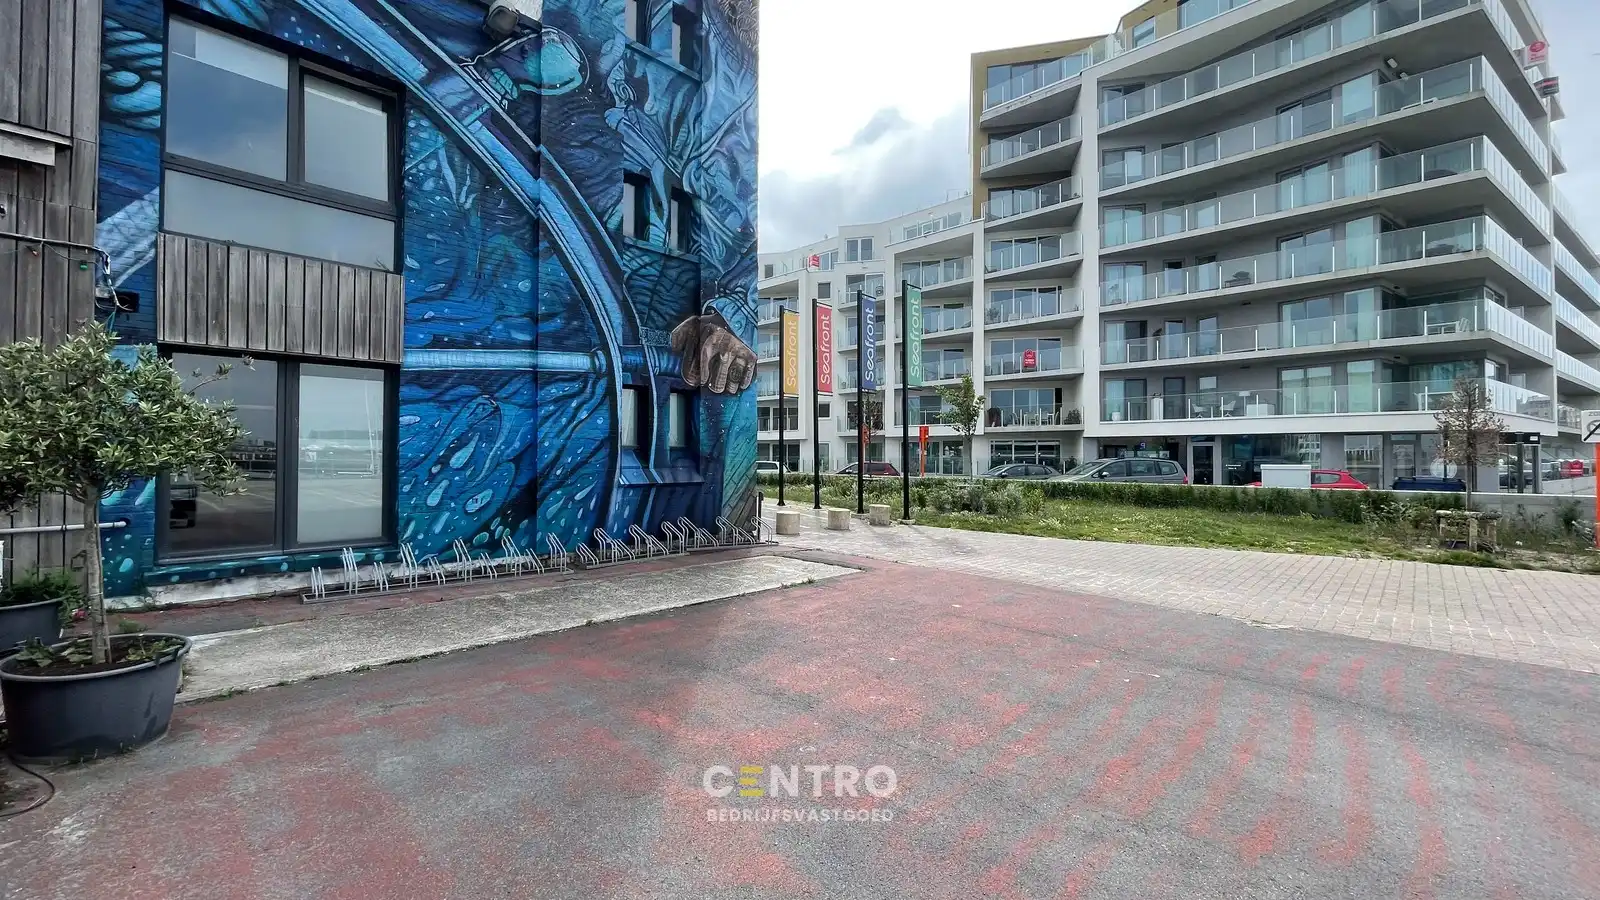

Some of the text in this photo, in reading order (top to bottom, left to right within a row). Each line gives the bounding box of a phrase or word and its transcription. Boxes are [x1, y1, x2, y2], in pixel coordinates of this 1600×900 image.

[787, 321, 797, 387] Seafront
[820, 315, 830, 385] Seafront
[865, 307, 874, 382] Seafront
[910, 299, 920, 378] Seafront
